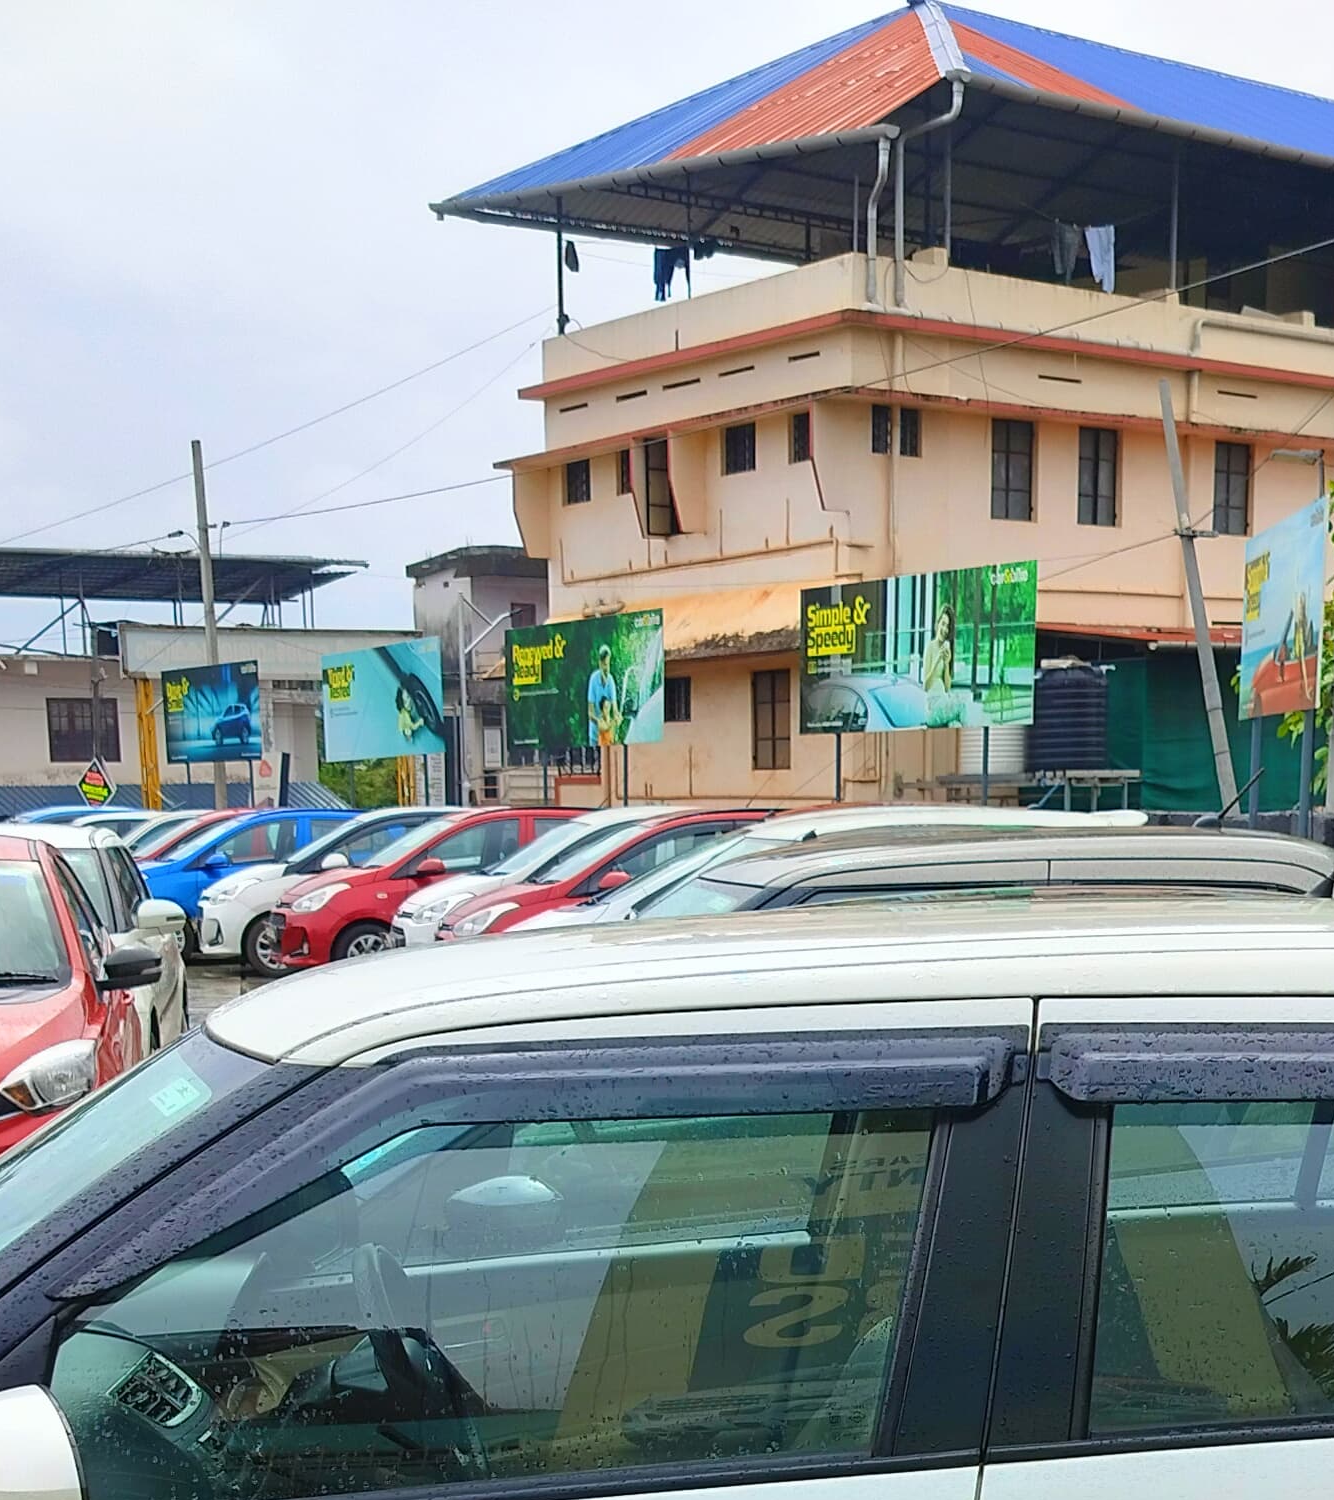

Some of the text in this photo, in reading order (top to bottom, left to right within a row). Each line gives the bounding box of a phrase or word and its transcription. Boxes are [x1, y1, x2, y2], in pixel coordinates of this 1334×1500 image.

[807, 595, 871, 627] Simple &
[512, 633, 566, 664] Renewed &
[807, 626, 854, 653] Speedy
